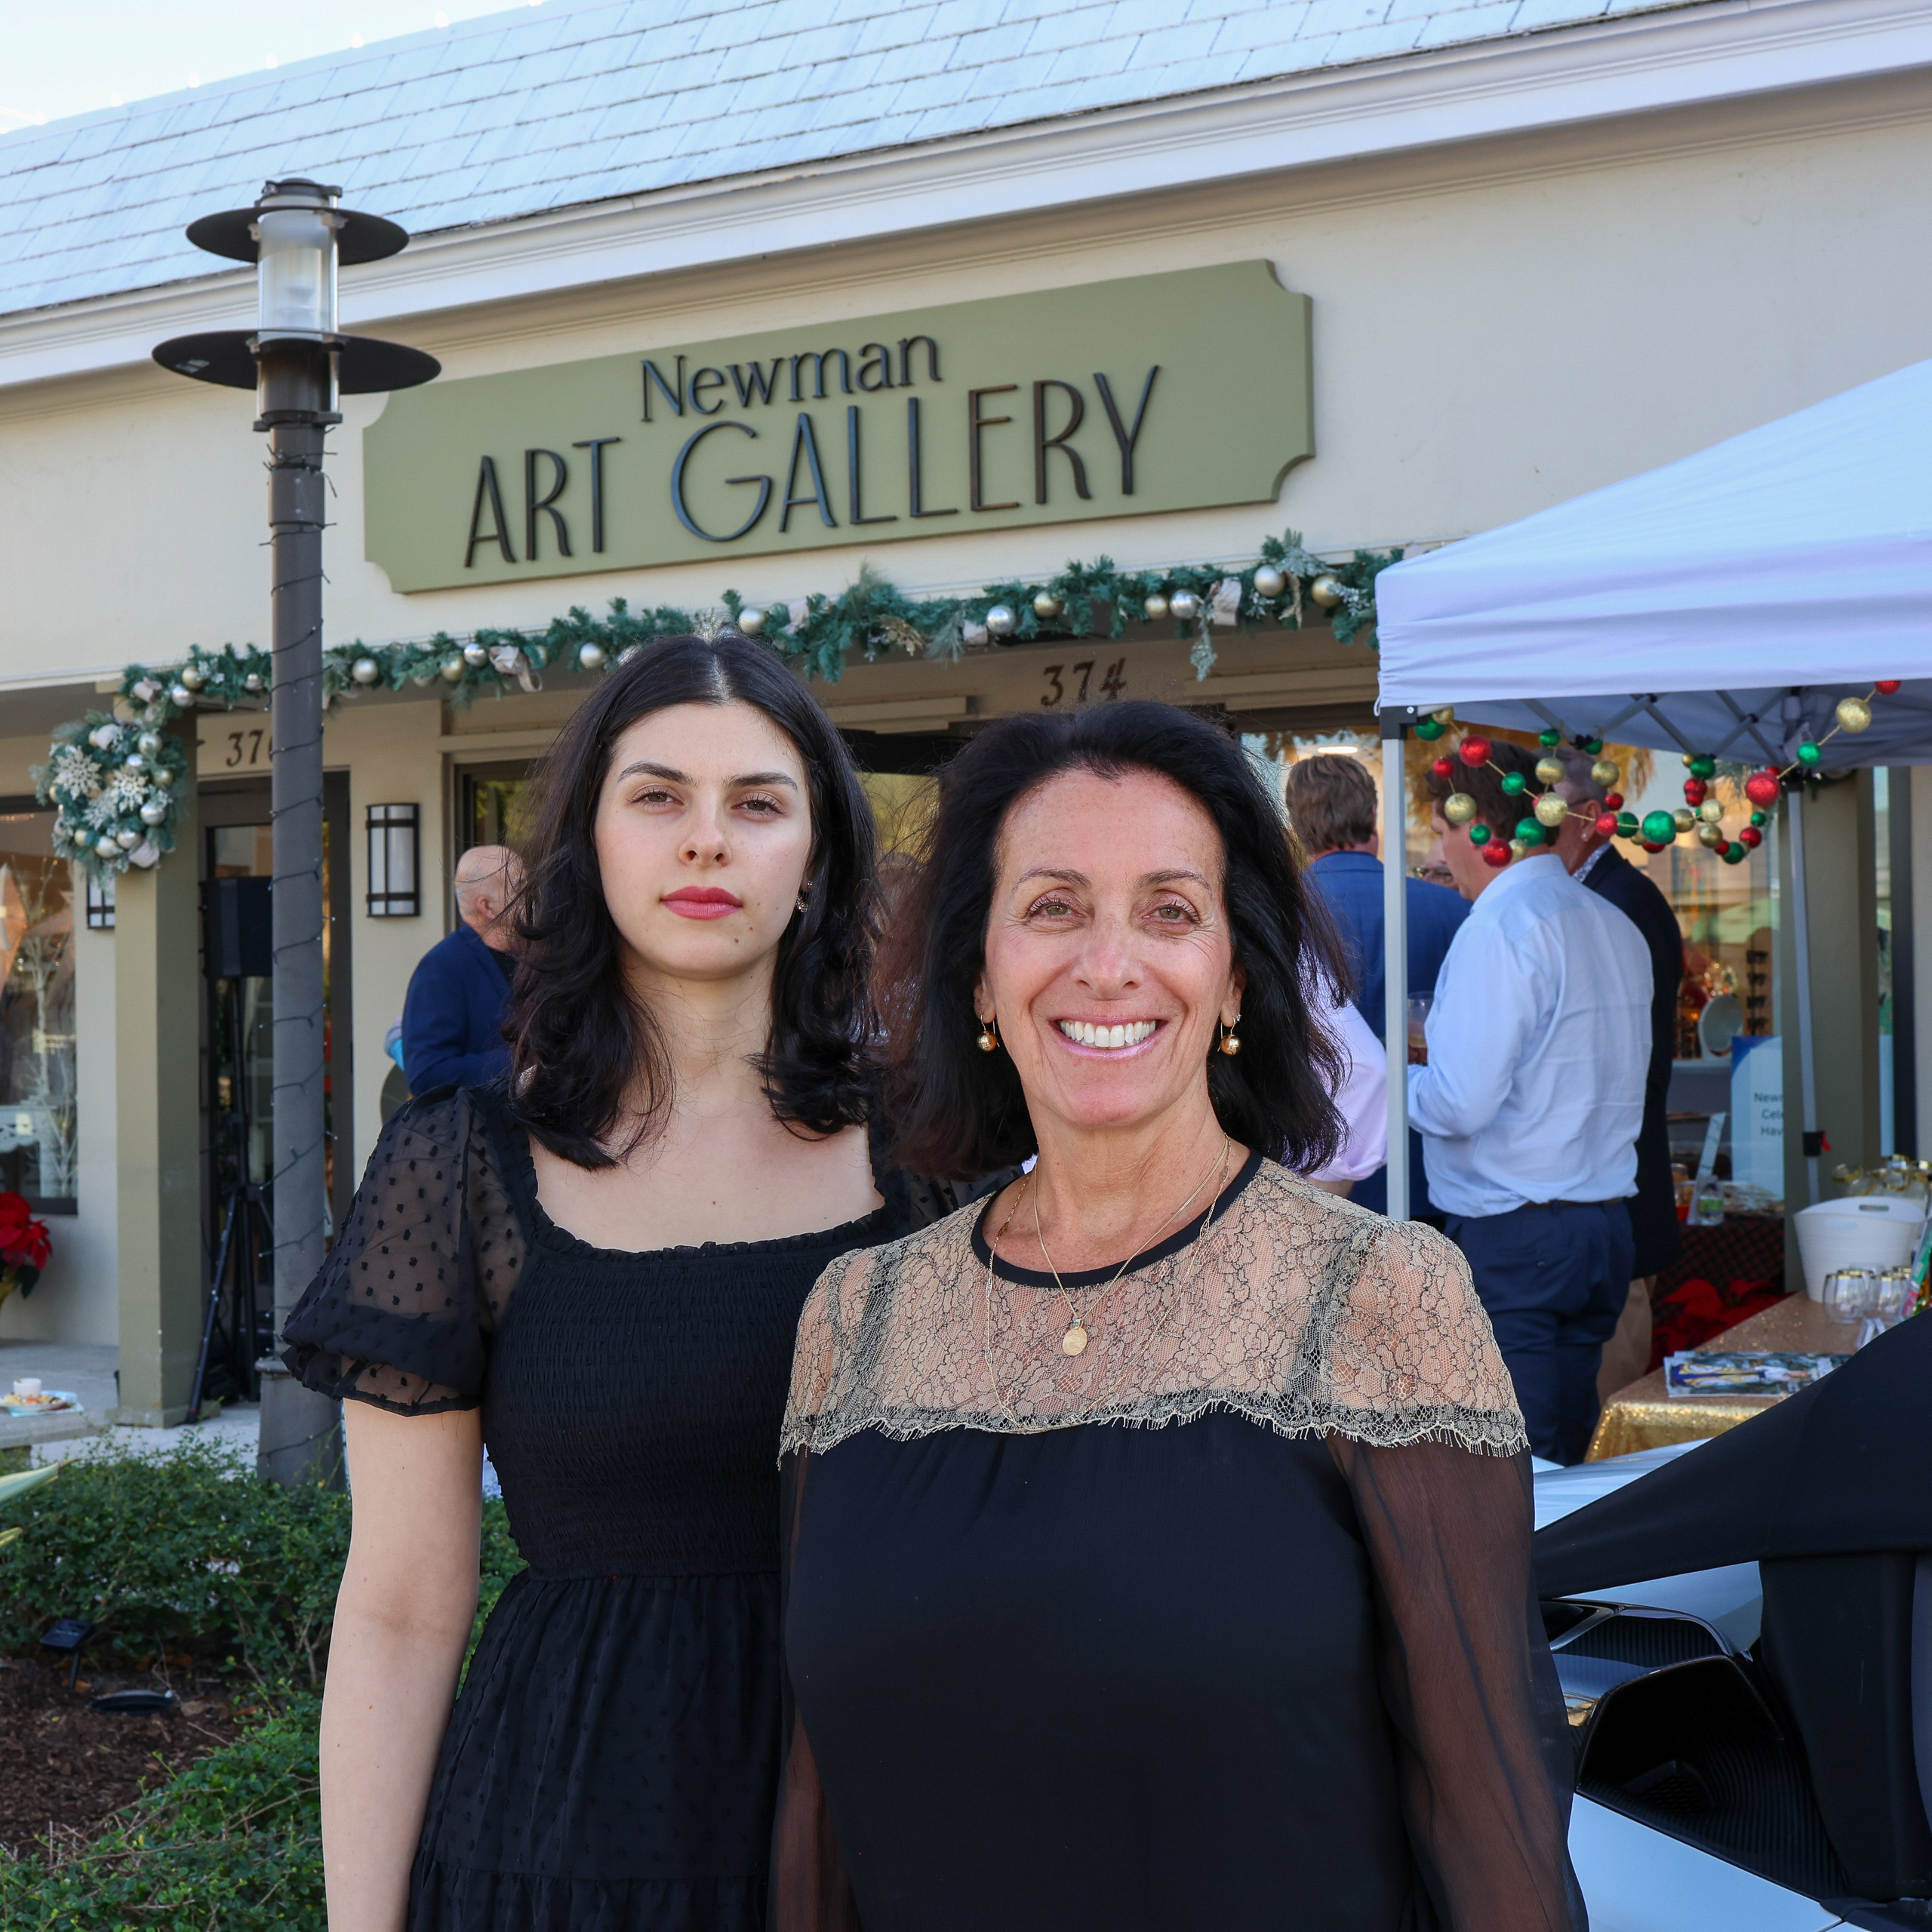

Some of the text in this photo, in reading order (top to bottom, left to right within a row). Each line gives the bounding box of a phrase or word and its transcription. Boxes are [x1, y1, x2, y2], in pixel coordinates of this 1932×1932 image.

[641, 335, 942, 422] Newman
[463, 365, 1160, 568] ART GALLERY
[1041, 657, 1126, 706] 374
[226, 728, 273, 767] 37
